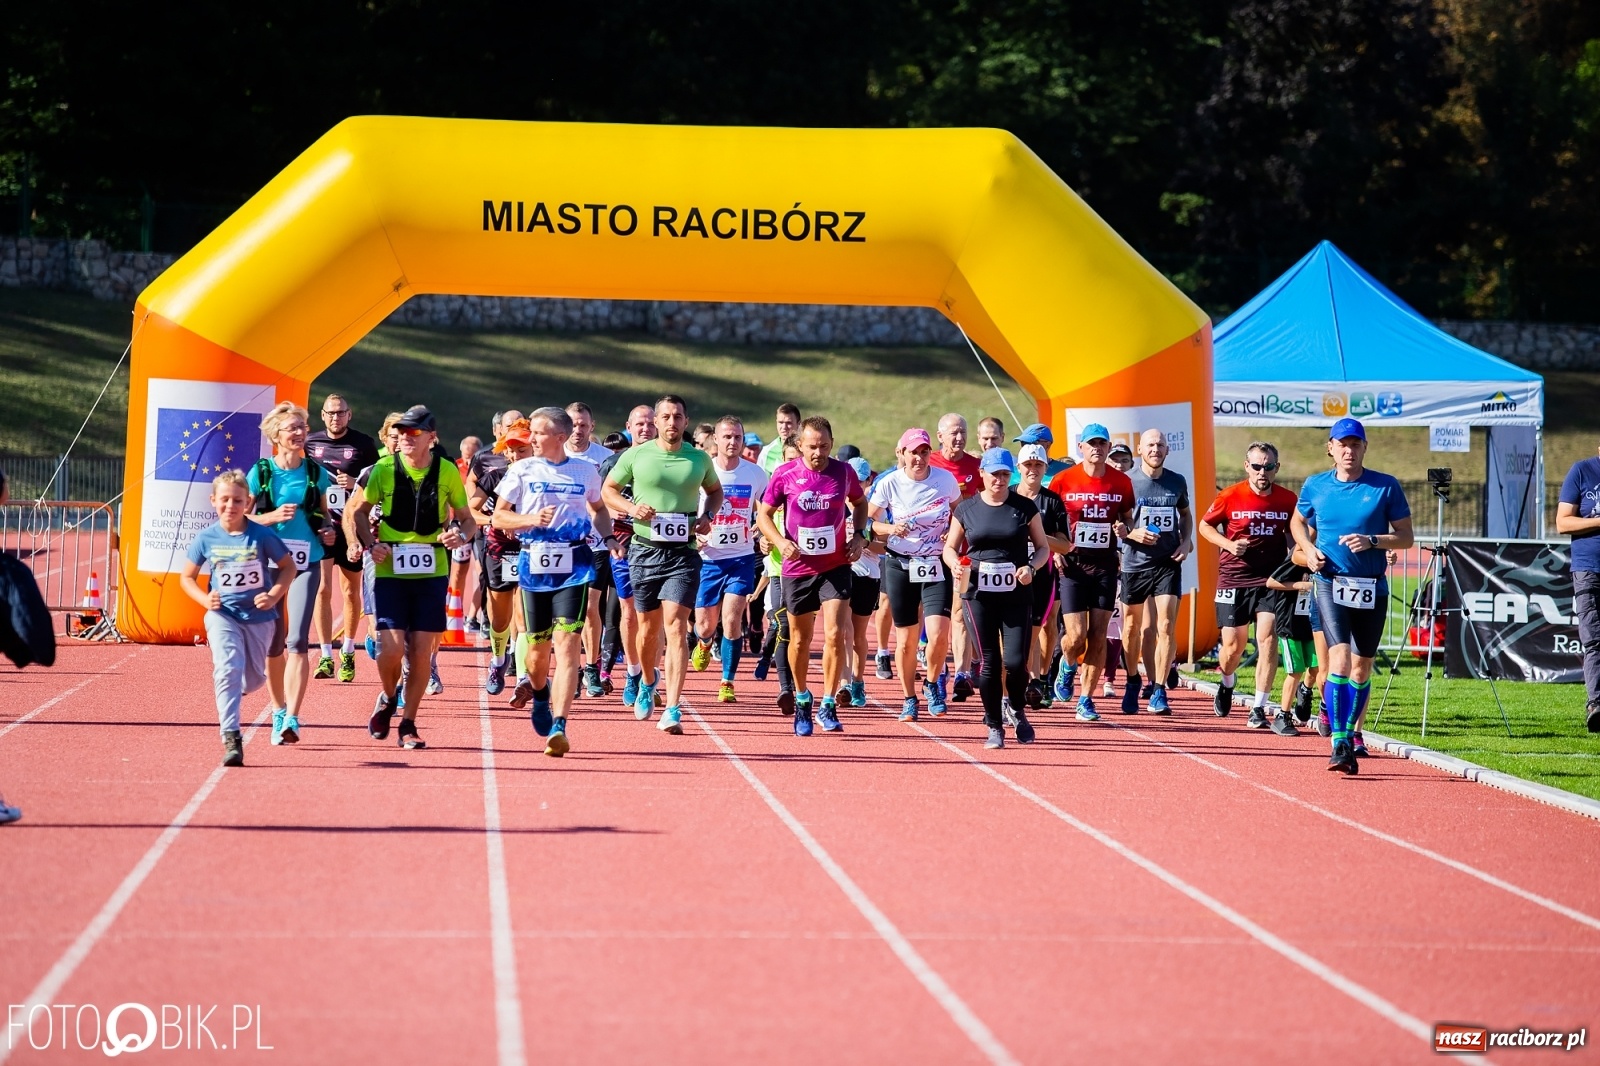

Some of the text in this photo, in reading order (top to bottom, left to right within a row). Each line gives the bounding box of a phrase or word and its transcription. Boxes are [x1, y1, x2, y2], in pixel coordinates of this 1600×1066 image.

[482, 200, 867, 243] MIASTO RACIBÓRZ
[1481, 402, 1517, 412] MITKO
[1435, 428, 1464, 437] POMIAR
[1437, 439, 1462, 448] CZASU
[804, 501, 830, 510] WORLD
[160, 509, 182, 518] UNIA
[1143, 515, 1172, 527] 185
[653, 522, 687, 536] 166
[719, 532, 739, 544] 29
[806, 537, 828, 550] 59
[1078, 530, 1109, 544] 145
[396, 554, 433, 568] 109
[539, 553, 563, 568] 67
[917, 565, 938, 578] 64
[221, 571, 260, 587] 223
[981, 572, 1014, 586] 100
[1336, 587, 1373, 603] 178
[1552, 634, 1586, 654] Ra
